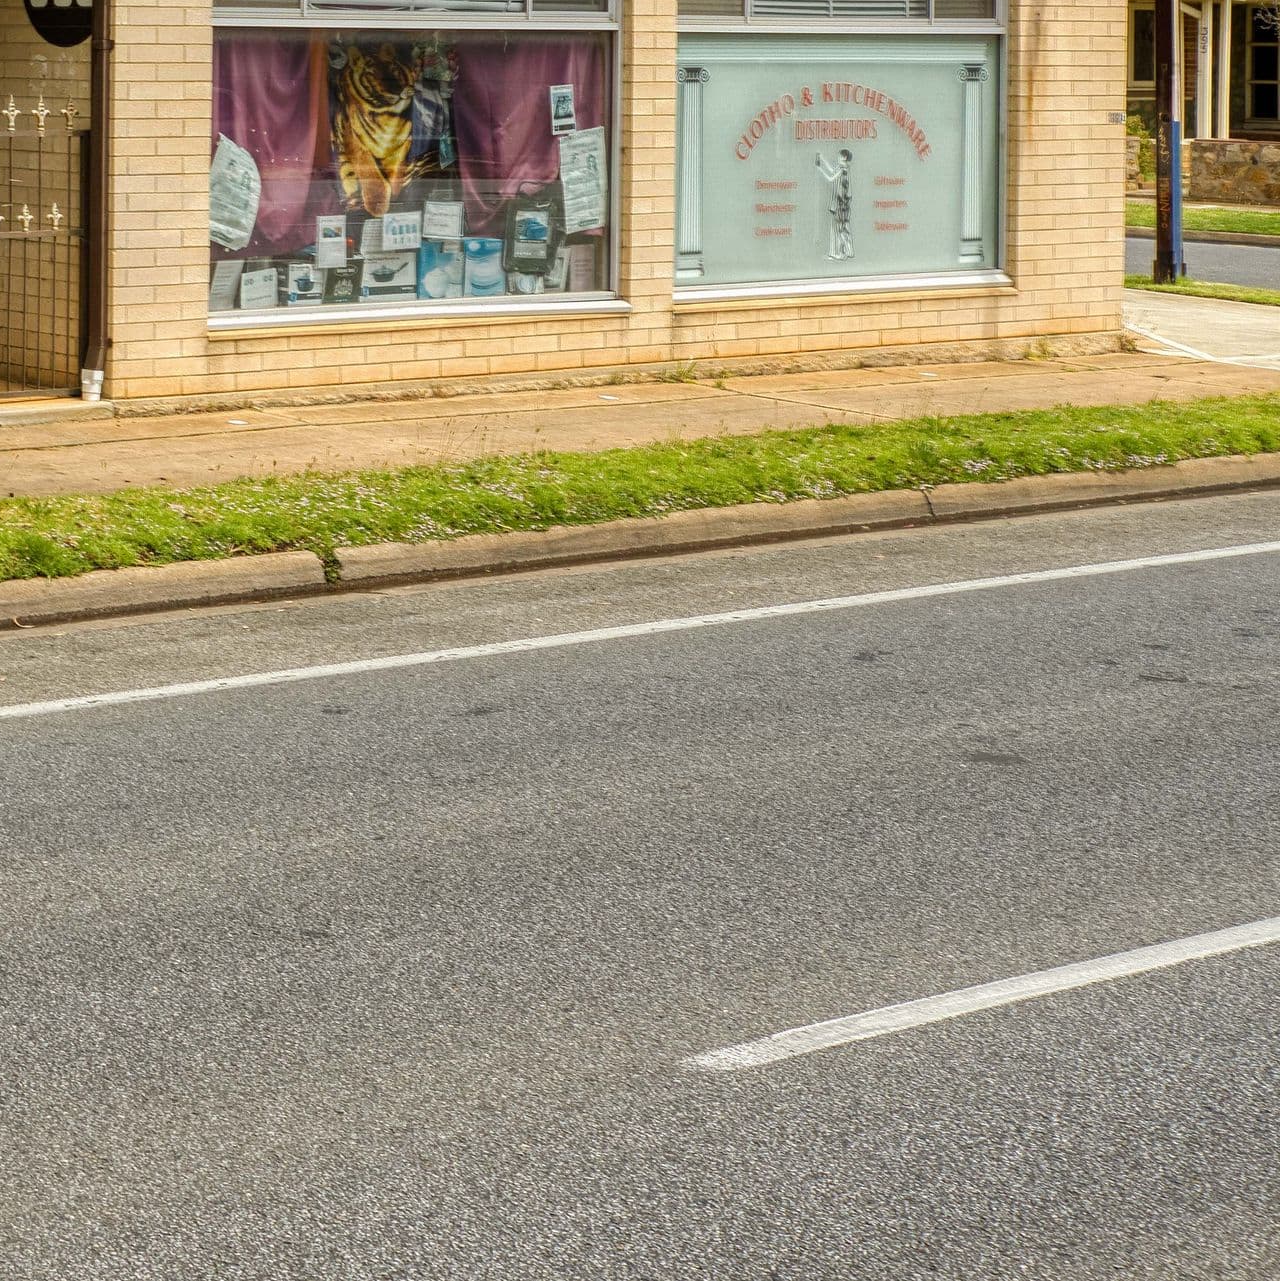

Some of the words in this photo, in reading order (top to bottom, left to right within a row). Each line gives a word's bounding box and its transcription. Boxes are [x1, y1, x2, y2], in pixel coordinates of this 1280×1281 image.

[735, 94, 796, 161] CLOTHO
[800, 86, 815, 108] &
[821, 82, 932, 161] KITCHENWARE
[794, 120, 879, 141] DISTRIBUTORS
